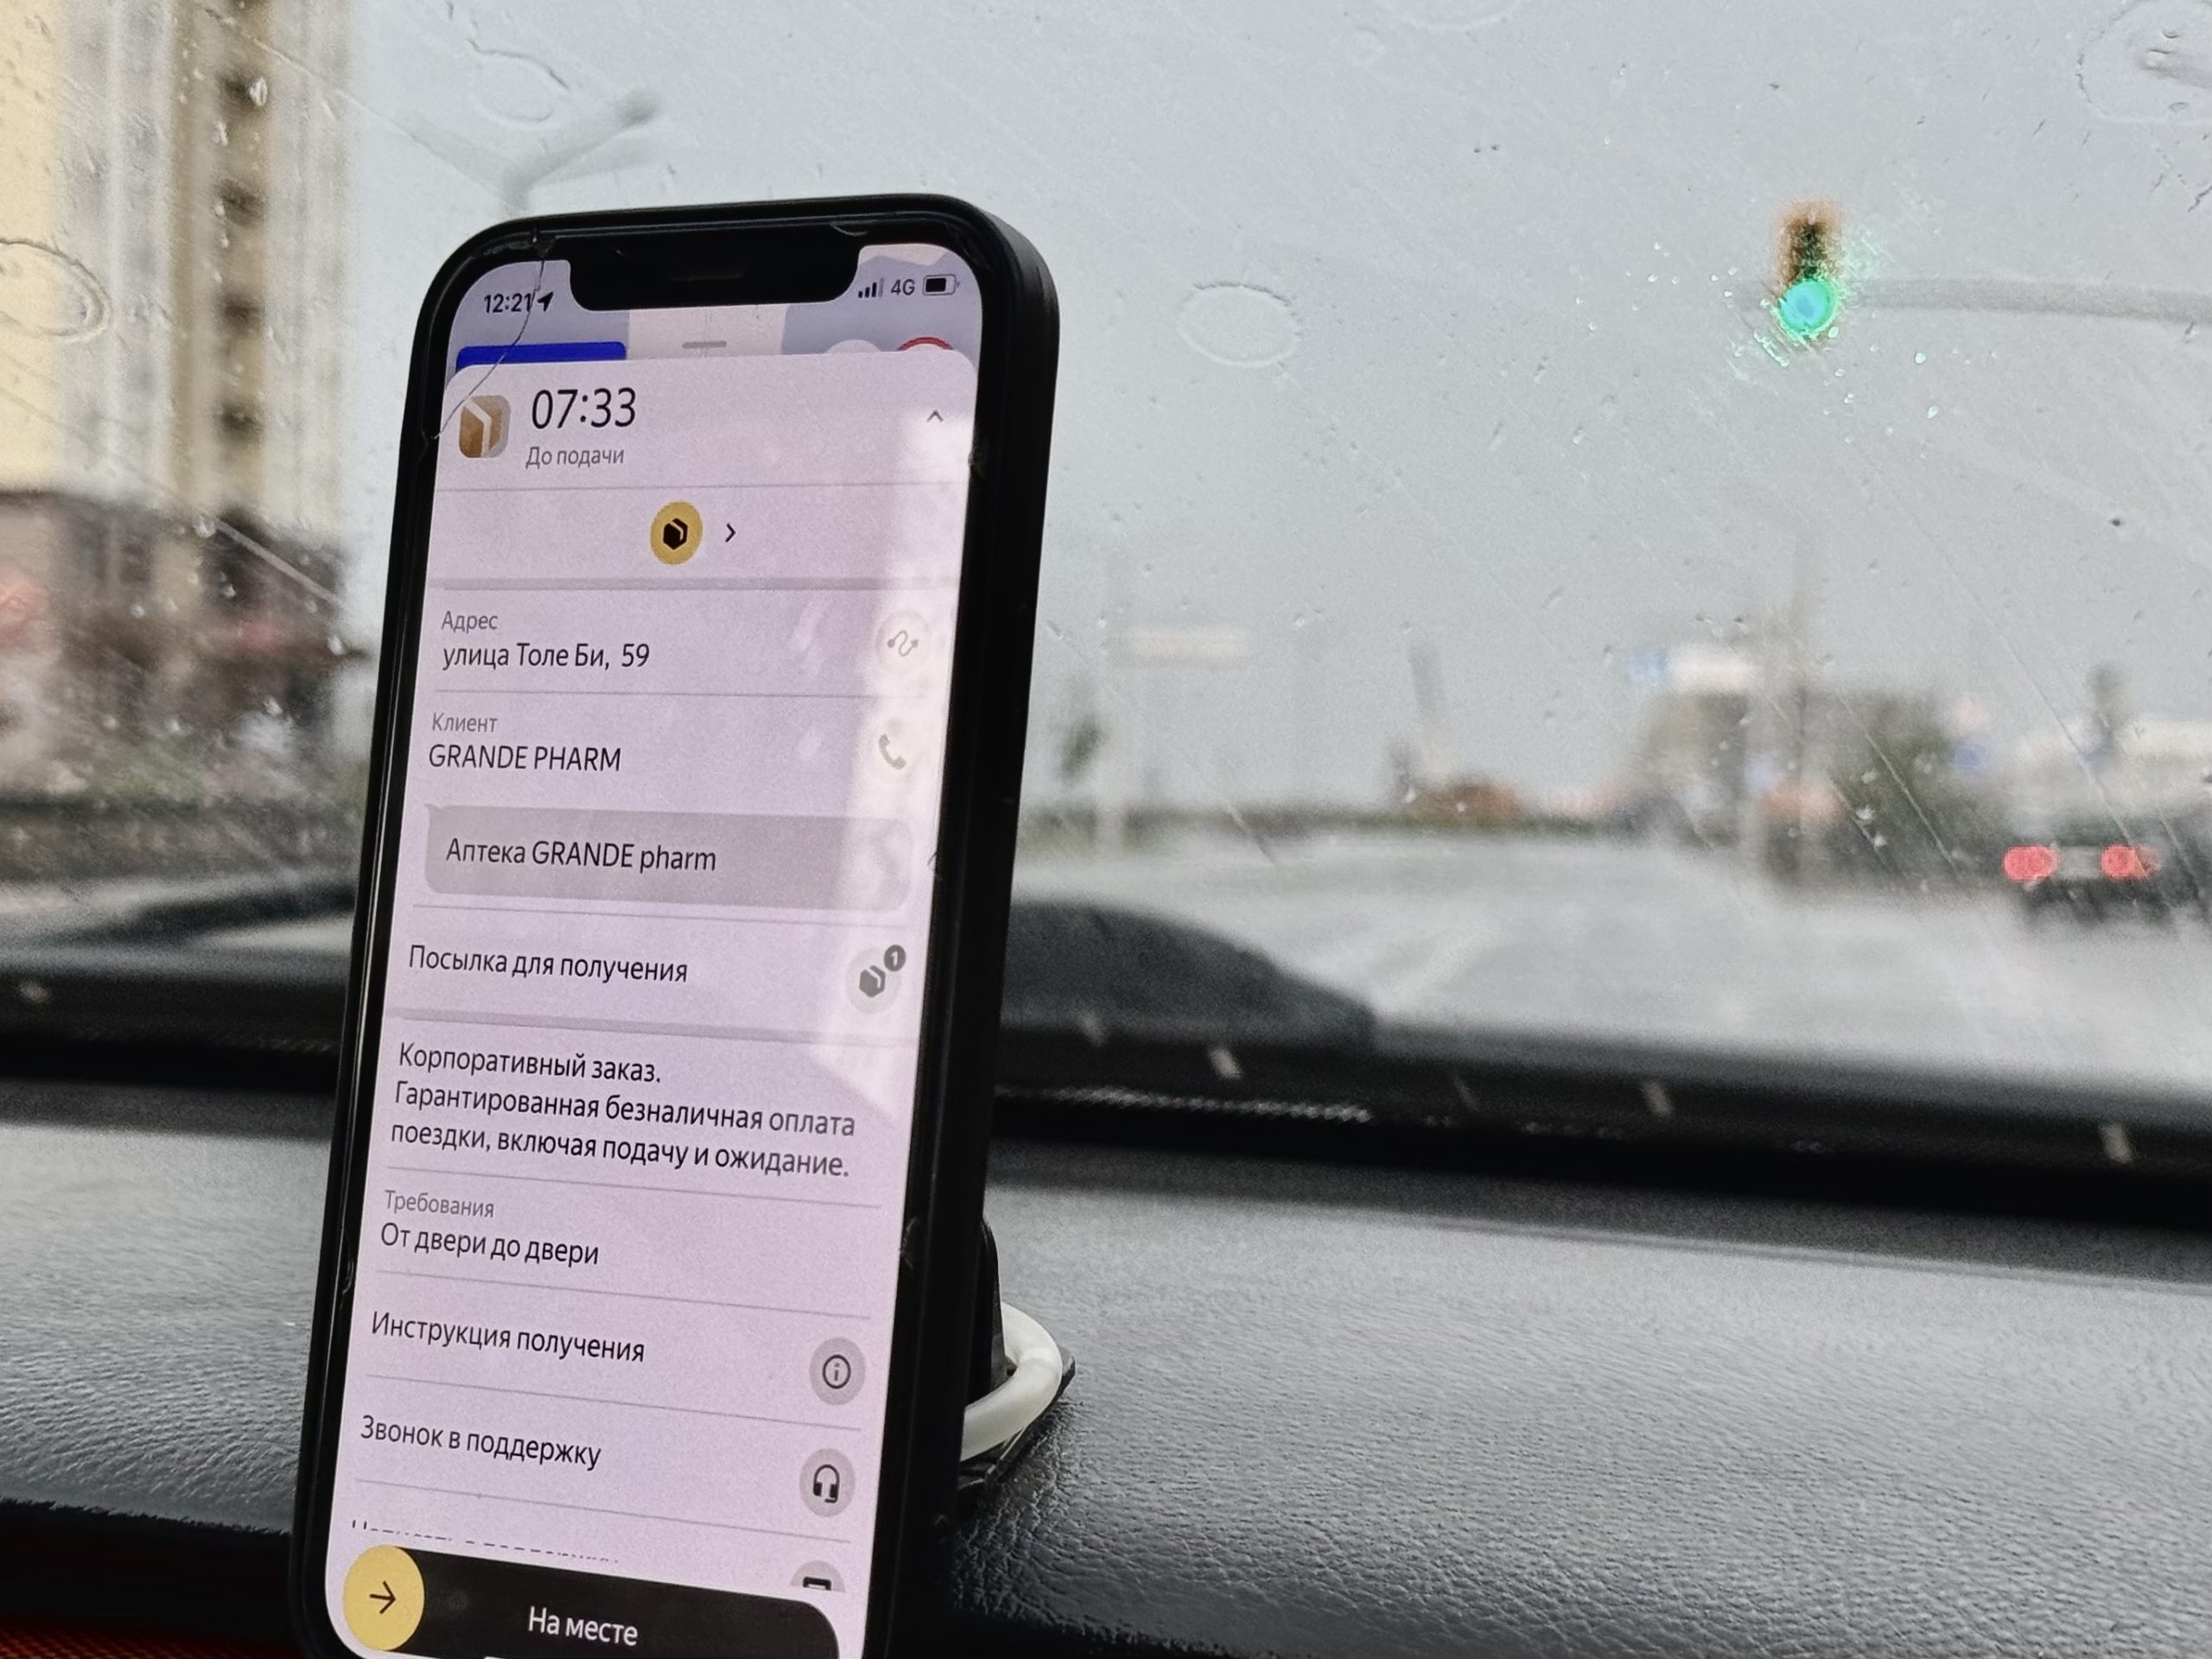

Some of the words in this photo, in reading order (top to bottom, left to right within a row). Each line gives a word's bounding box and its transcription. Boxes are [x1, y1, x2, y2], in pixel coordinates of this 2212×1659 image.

[483, 292, 531, 315] 12:21
[890, 278, 915, 296] 4G
[531, 386, 636, 429] 07:33
[524, 446, 553, 470] До
[556, 448, 625, 468] подачи
[441, 610, 499, 634] Адрес
[442, 647, 510, 671] улица
[516, 642, 569, 667] Толе
[575, 643, 610, 671] Би,
[621, 643, 650, 668] 59
[431, 712, 499, 733] Клиент
[429, 743, 529, 770] GRANDE
[534, 746, 621, 772] PHARM
[446, 837, 526, 864] Аптека
[531, 840, 635, 868] GRANDE
[639, 844, 716, 874] pharm
[409, 944, 508, 973] Посылка
[511, 956, 555, 978] для
[560, 957, 688, 984] получения
[399, 1042, 587, 1078] Корпоративный
[591, 1060, 661, 1084] заказ.
[395, 1080, 600, 1118] Гарантированная
[606, 1094, 763, 1129] безналичная
[768, 1112, 855, 1136] оплата
[391, 1124, 491, 1153] поездки,
[498, 1132, 597, 1158] включая
[602, 1140, 689, 1170] подачу
[694, 1147, 709, 1166] и
[715, 1148, 849, 1178] ожидание.
[385, 1189, 494, 1218] Требования
[381, 1222, 411, 1248] От
[414, 1230, 486, 1258] двери
[490, 1237, 521, 1262] до
[524, 1241, 599, 1268] двери
[372, 1311, 511, 1351] Инструкция
[517, 1332, 645, 1363] получения
[360, 1414, 444, 1448] Звонок
[448, 1431, 461, 1449] в
[467, 1433, 602, 1471] поддержку
[528, 1605, 561, 1636] На
[565, 1617, 639, 1647] месте
